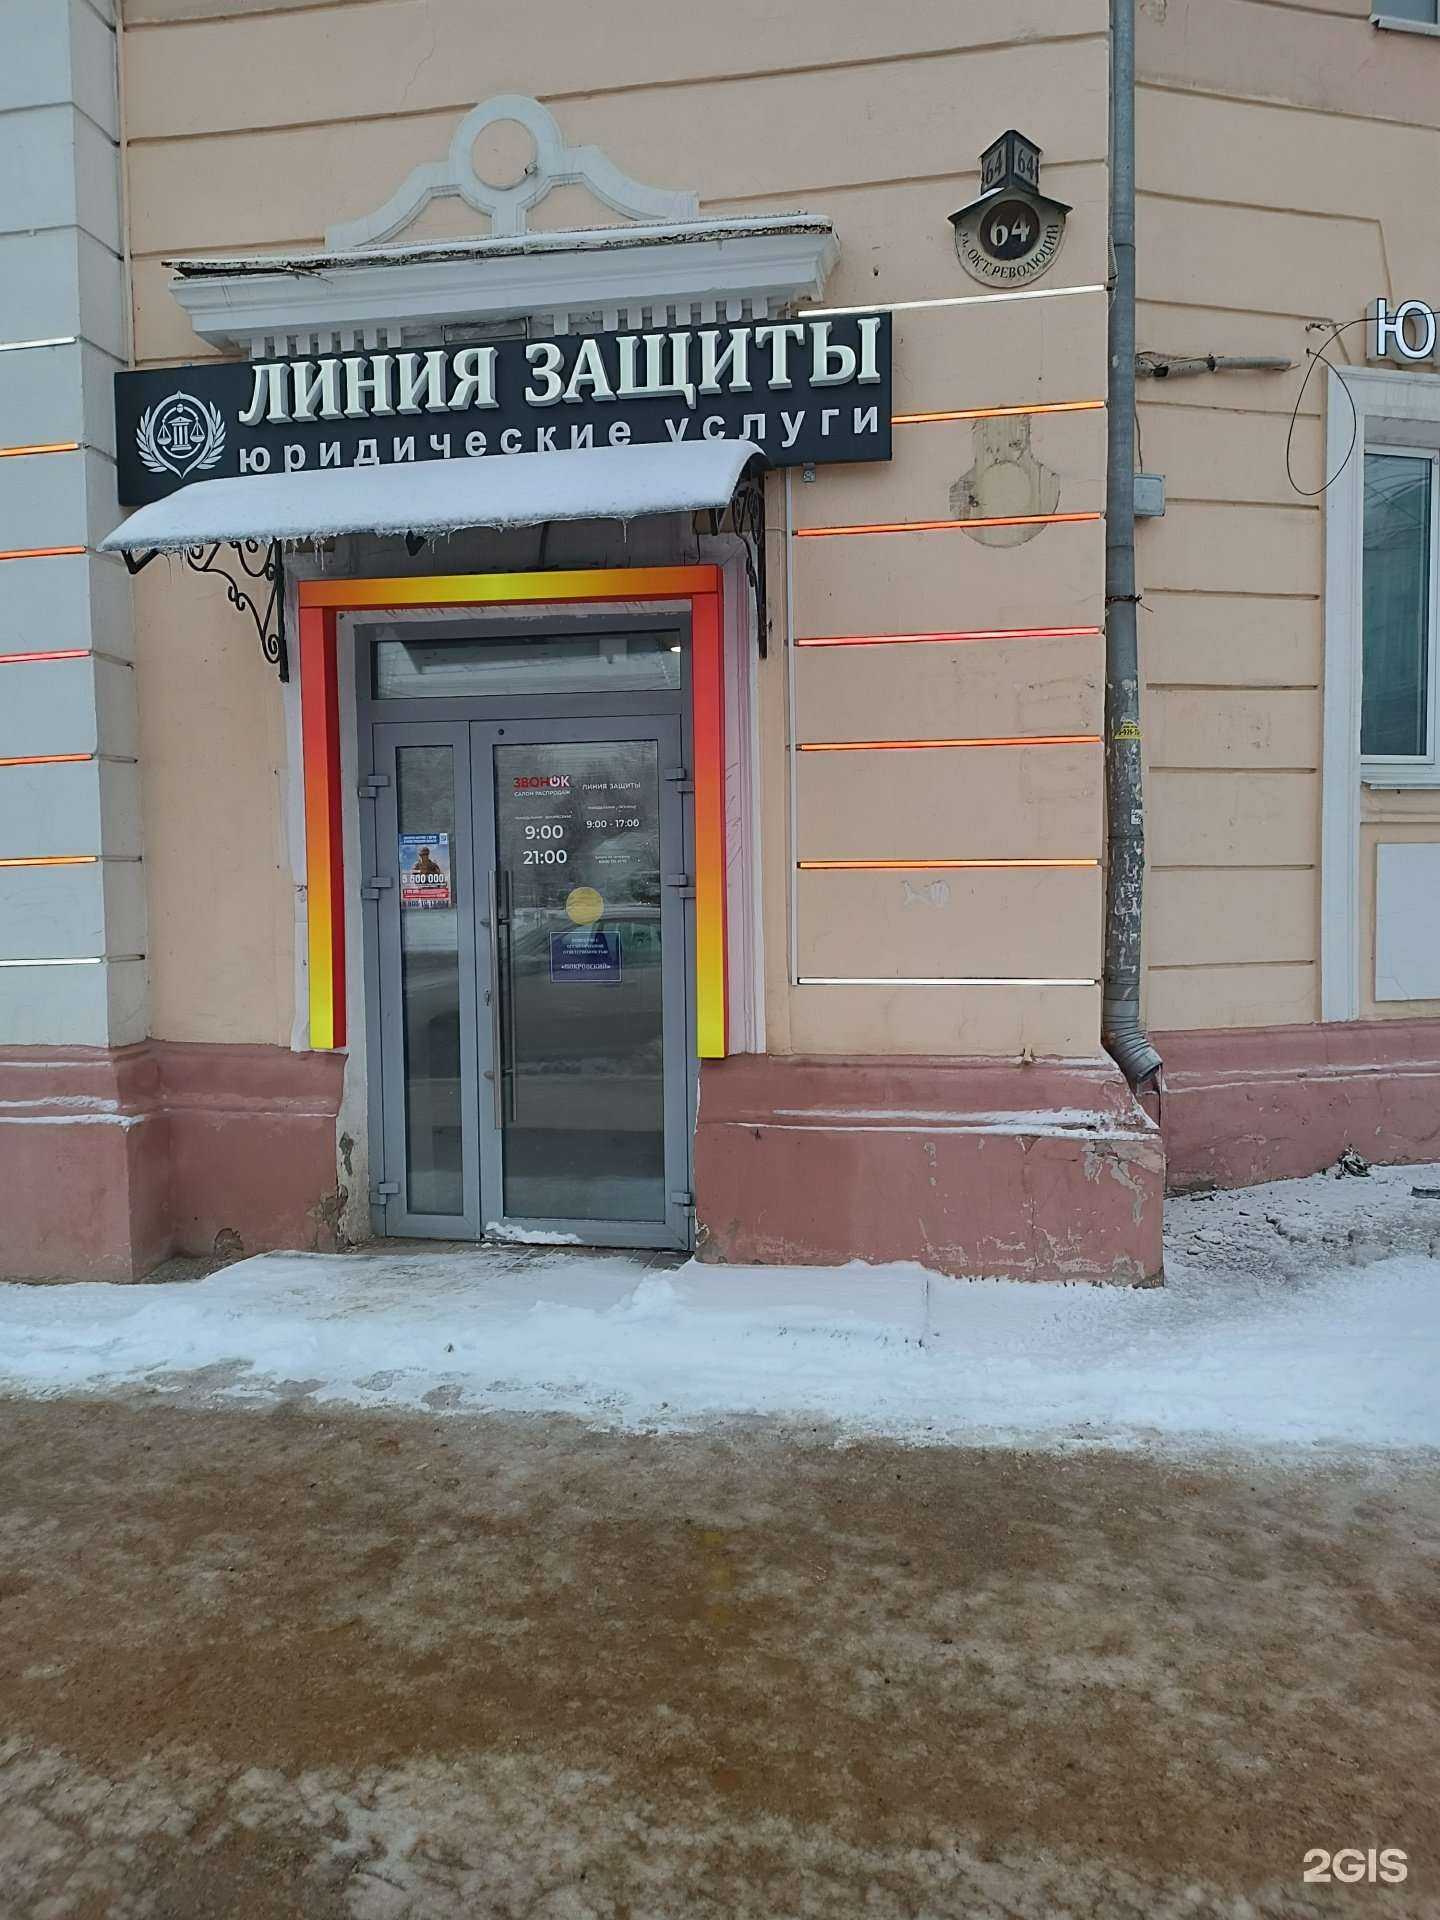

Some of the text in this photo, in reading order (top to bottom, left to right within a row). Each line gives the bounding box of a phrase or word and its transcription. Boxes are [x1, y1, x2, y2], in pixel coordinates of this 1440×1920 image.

[1018, 148, 1035, 180] 64
[990, 213, 1031, 248] 64
[992, 224, 1060, 279] РЕВОЛЮЦИИ
[1376, 297, 1437, 360] Ю
[238, 317, 881, 426] ЛИНИЯ ЗАЩИТЫ
[239, 405, 879, 473] юридические услуги
[512, 775, 570, 788] ЗВОНОК
[609, 781, 641, 789] ЗАЩИТЫ
[525, 825, 563, 839] 9:00
[586, 820, 607, 828] 9:00
[615, 818, 640, 828] 17:00
[522, 850, 567, 864] 21:00
